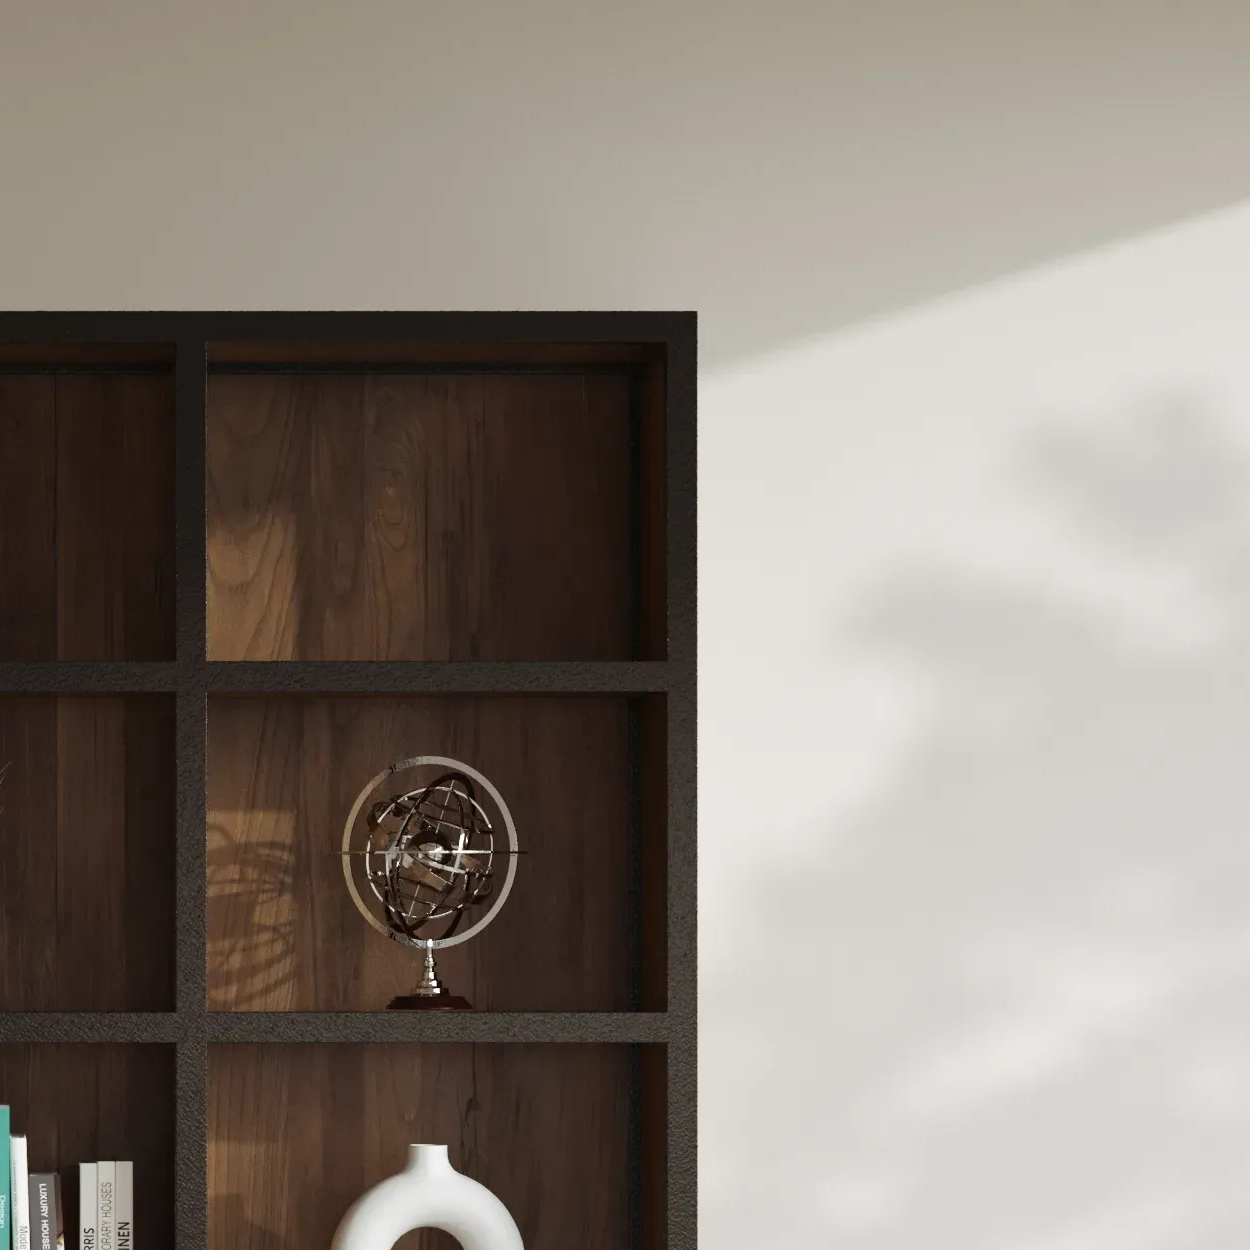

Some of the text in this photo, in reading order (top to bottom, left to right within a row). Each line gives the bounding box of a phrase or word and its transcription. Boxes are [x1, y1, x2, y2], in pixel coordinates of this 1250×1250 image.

[0, 1195, 7, 1229] Design
[39, 1183, 49, 1218] LUXURY
[100, 1181, 112, 1218] HOUSES
